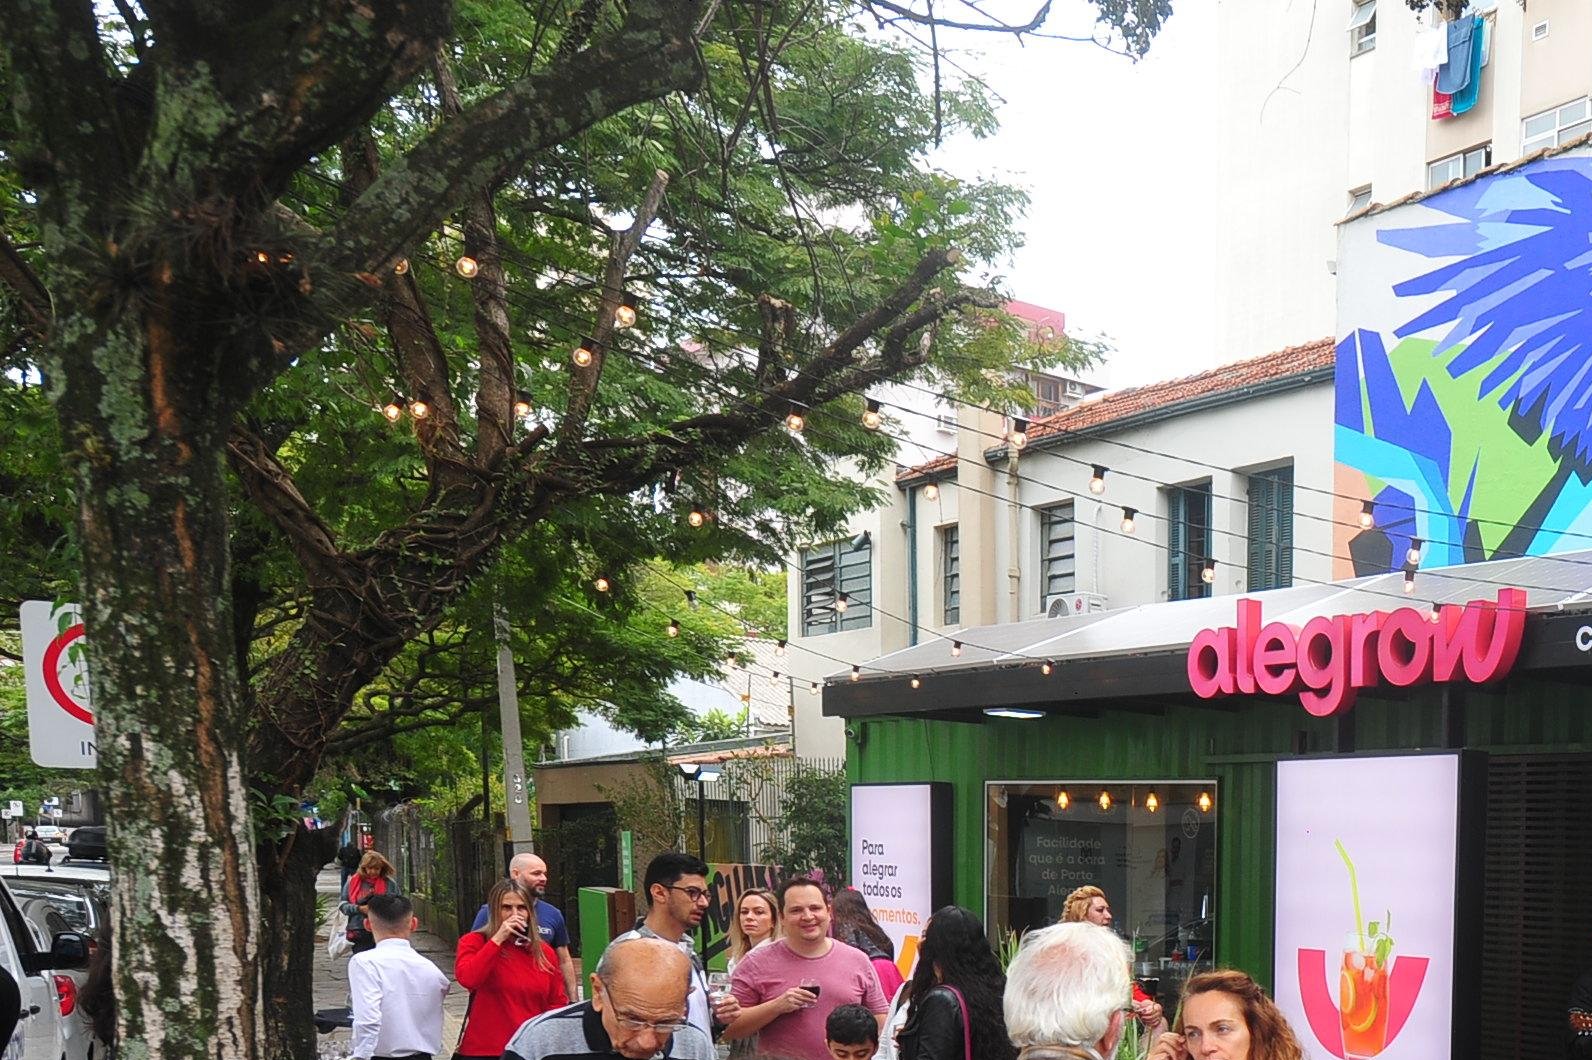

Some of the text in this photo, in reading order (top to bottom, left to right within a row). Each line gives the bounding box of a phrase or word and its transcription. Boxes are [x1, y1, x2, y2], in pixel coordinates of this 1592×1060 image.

[1187, 587, 1527, 717] alegrow
[861, 839, 884, 856] Para
[1036, 836, 1102, 849] Facilidade
[1029, 854, 1053, 866] que
[1056, 853, 1064, 864] é
[1067, 856, 1075, 865] a
[862, 860, 898, 880] alegrar
[1041, 869, 1094, 880] de Porto
[871, 907, 921, 925] omentos.
